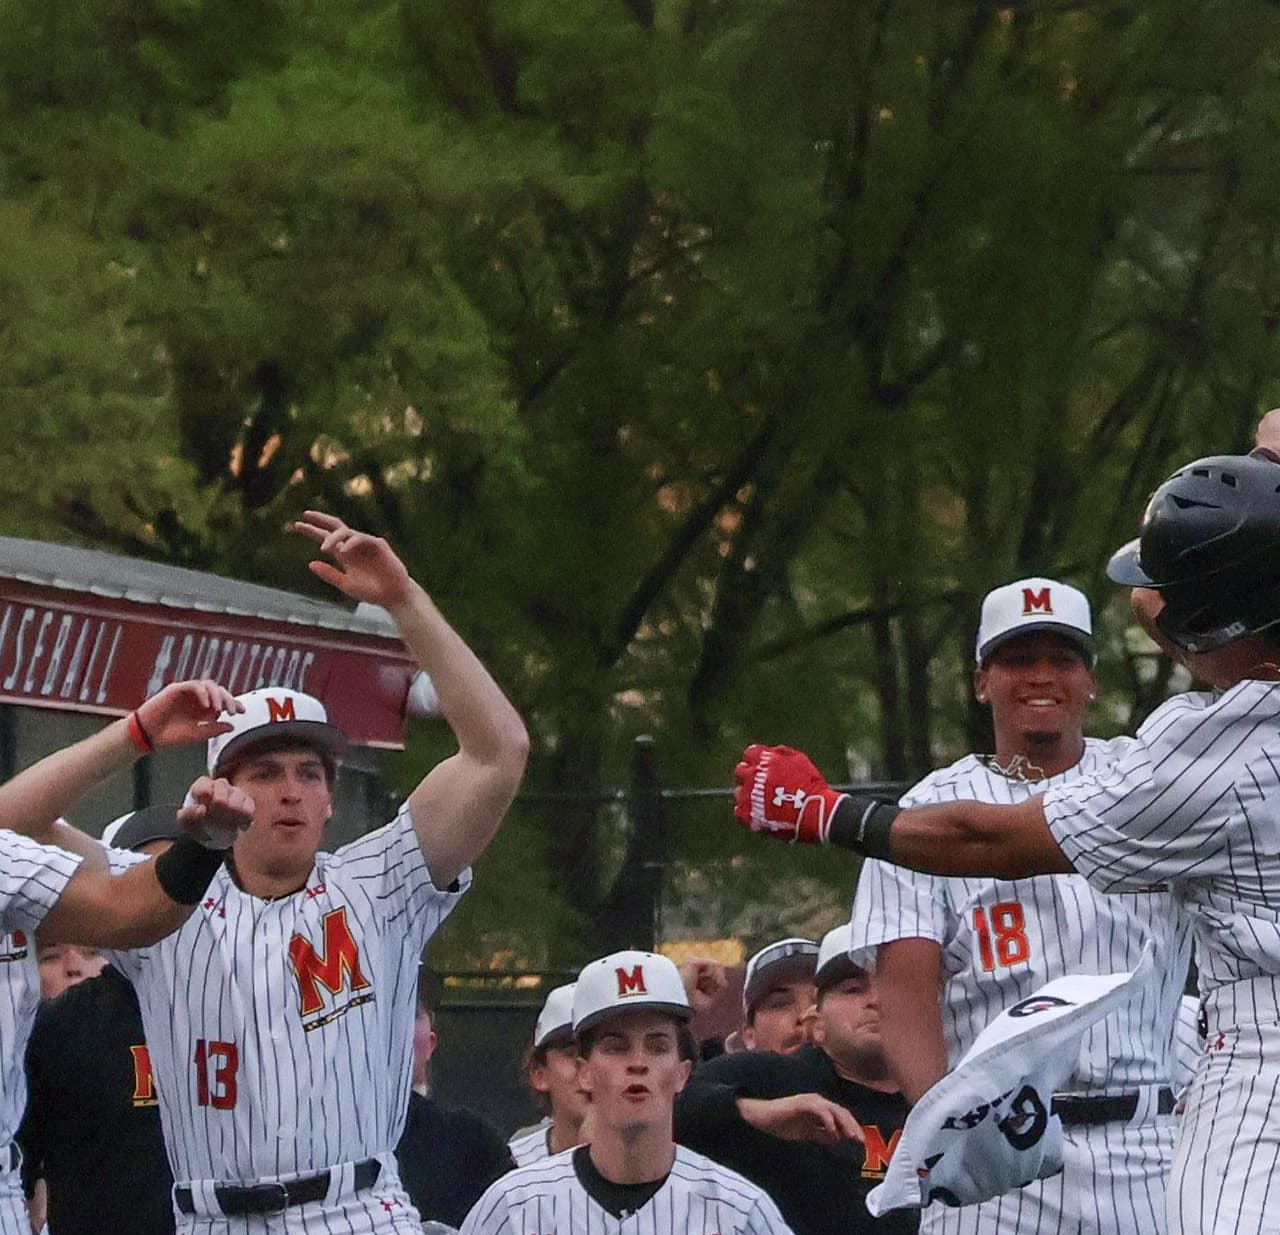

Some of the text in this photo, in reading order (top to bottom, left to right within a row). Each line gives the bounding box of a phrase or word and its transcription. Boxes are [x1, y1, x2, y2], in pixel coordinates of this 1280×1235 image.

[1022, 587, 1054, 613] M
[266, 697, 296, 722] M
[288, 905, 372, 1017] M
[972, 901, 1031, 973] 18
[615, 964, 647, 995] M
[194, 1038, 239, 1111] 13
